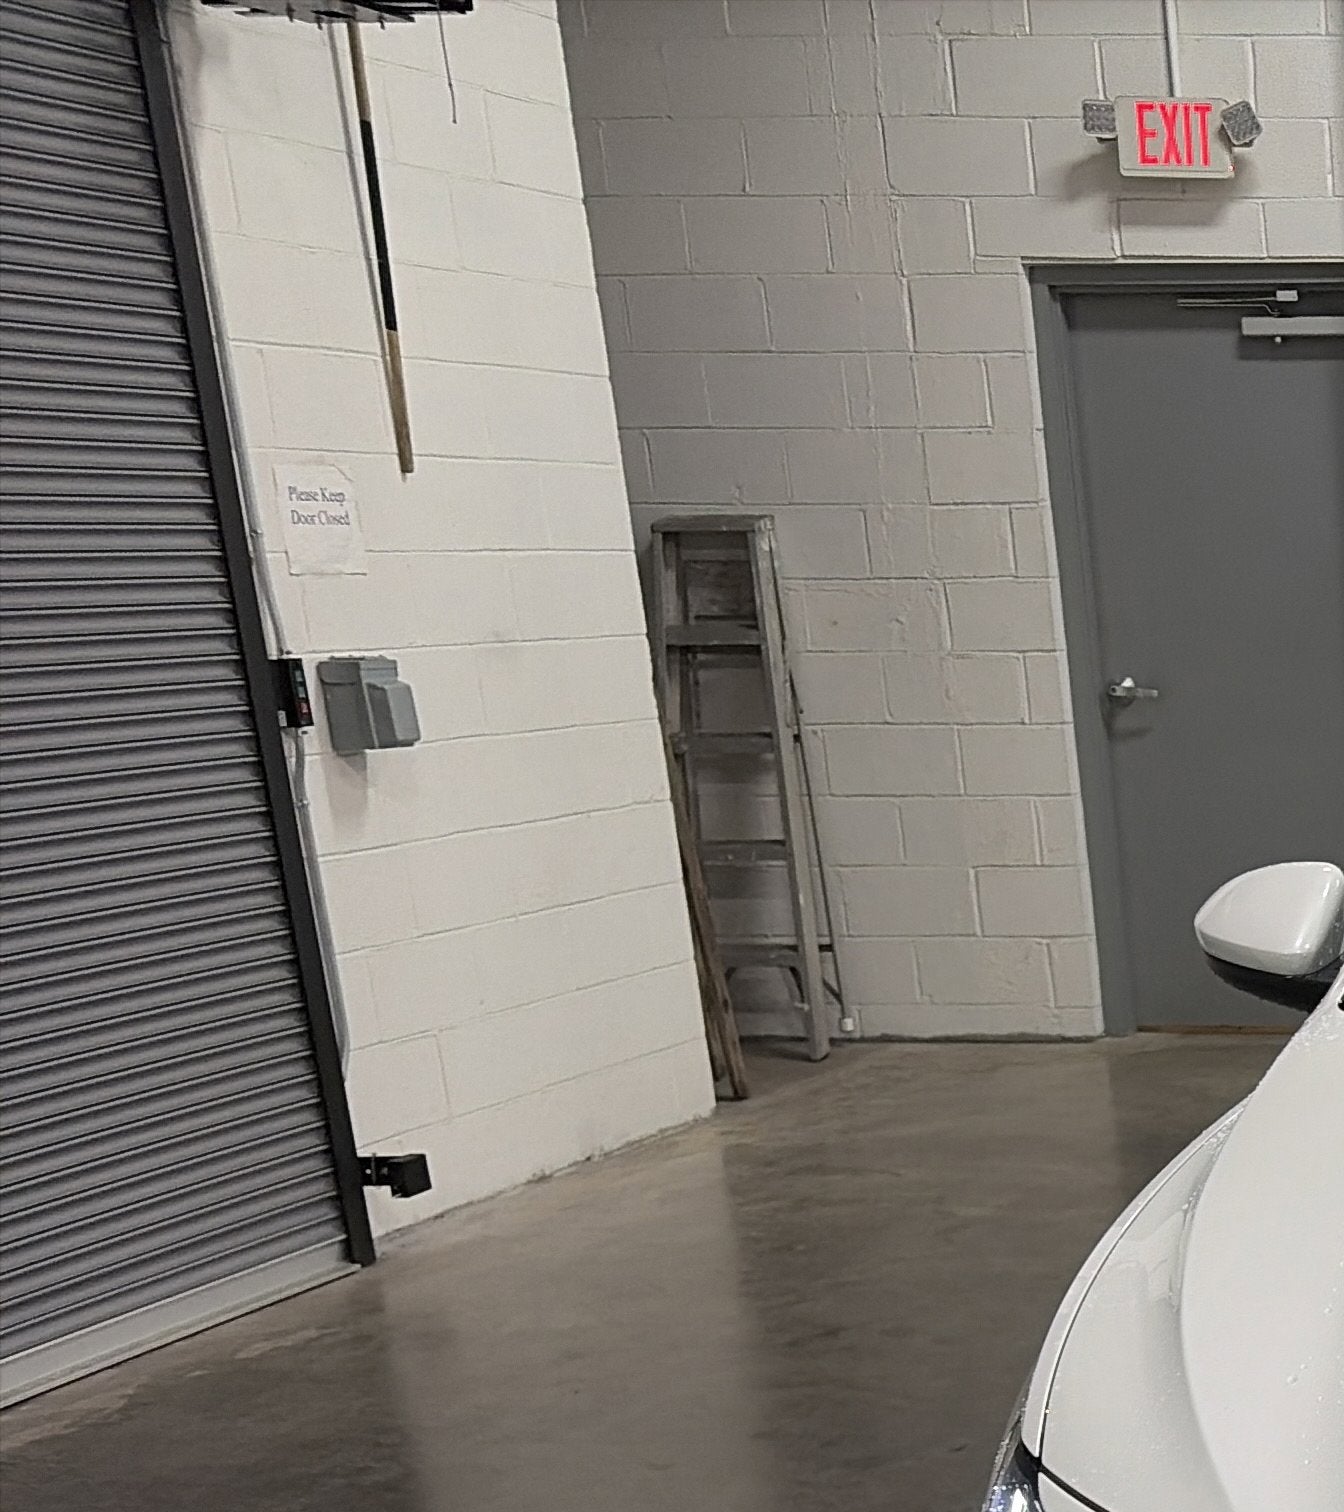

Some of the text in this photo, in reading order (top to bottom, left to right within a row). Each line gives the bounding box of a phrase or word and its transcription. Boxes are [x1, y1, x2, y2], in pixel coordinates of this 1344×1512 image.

[1135, 101, 1213, 167] EXIT
[288, 486, 346, 507] Please Keep
[290, 509, 350, 526] Door Closed
